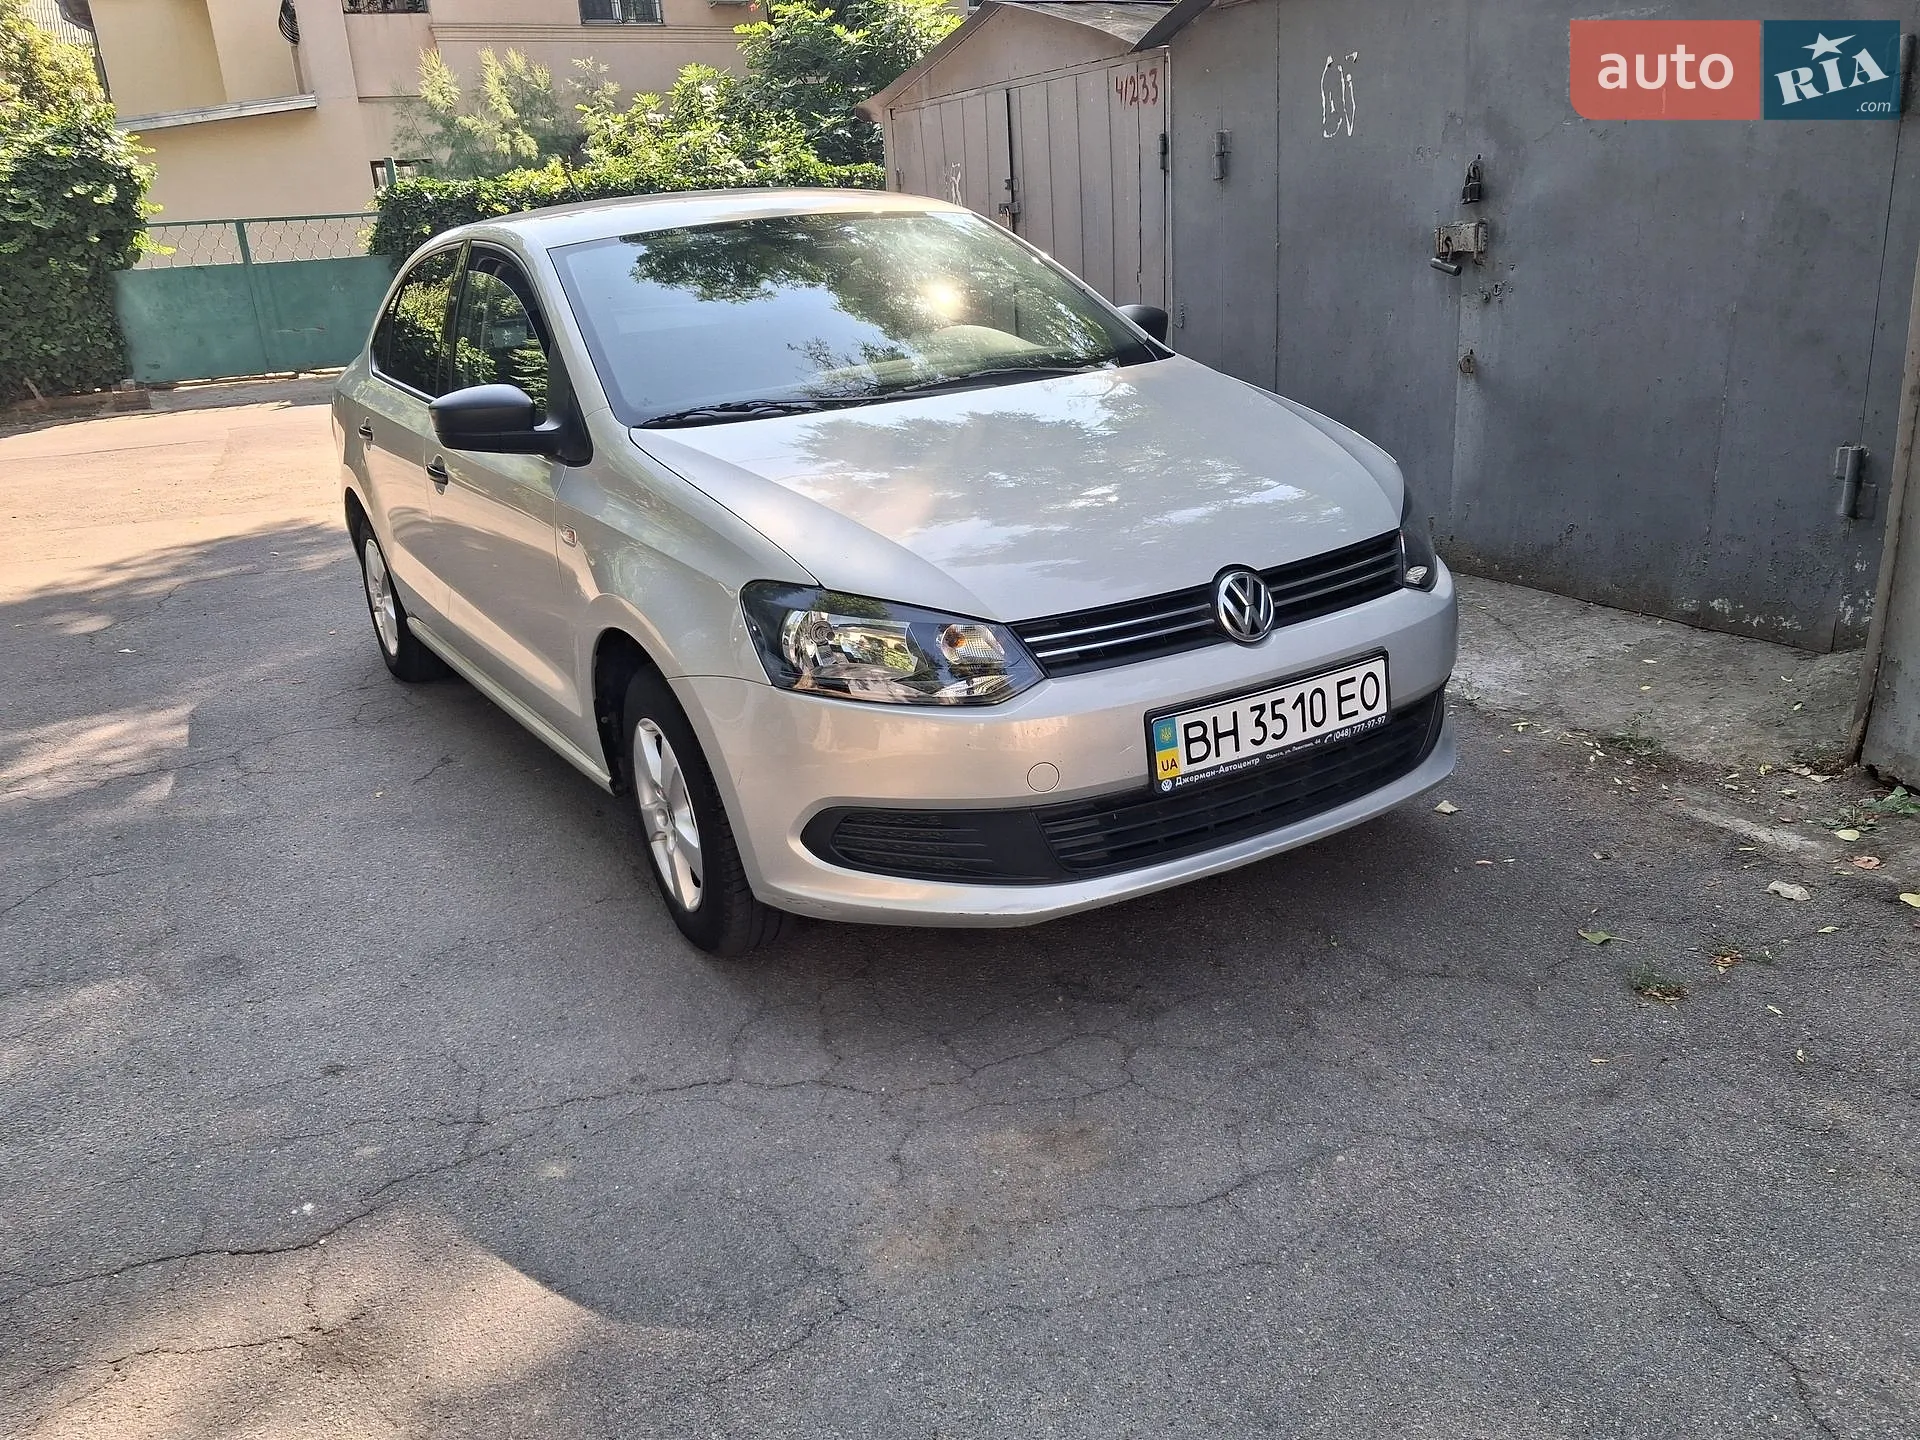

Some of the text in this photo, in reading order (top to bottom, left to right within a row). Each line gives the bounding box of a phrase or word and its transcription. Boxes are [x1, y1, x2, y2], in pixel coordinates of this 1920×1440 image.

[1183, 671, 1381, 766] BH 3510 EO
[1333, 715, 1386, 743] (048) 777-97-97
[1161, 757, 1179, 773] UA
[1175, 757, 1261, 788] Джерман-Автоцентр
